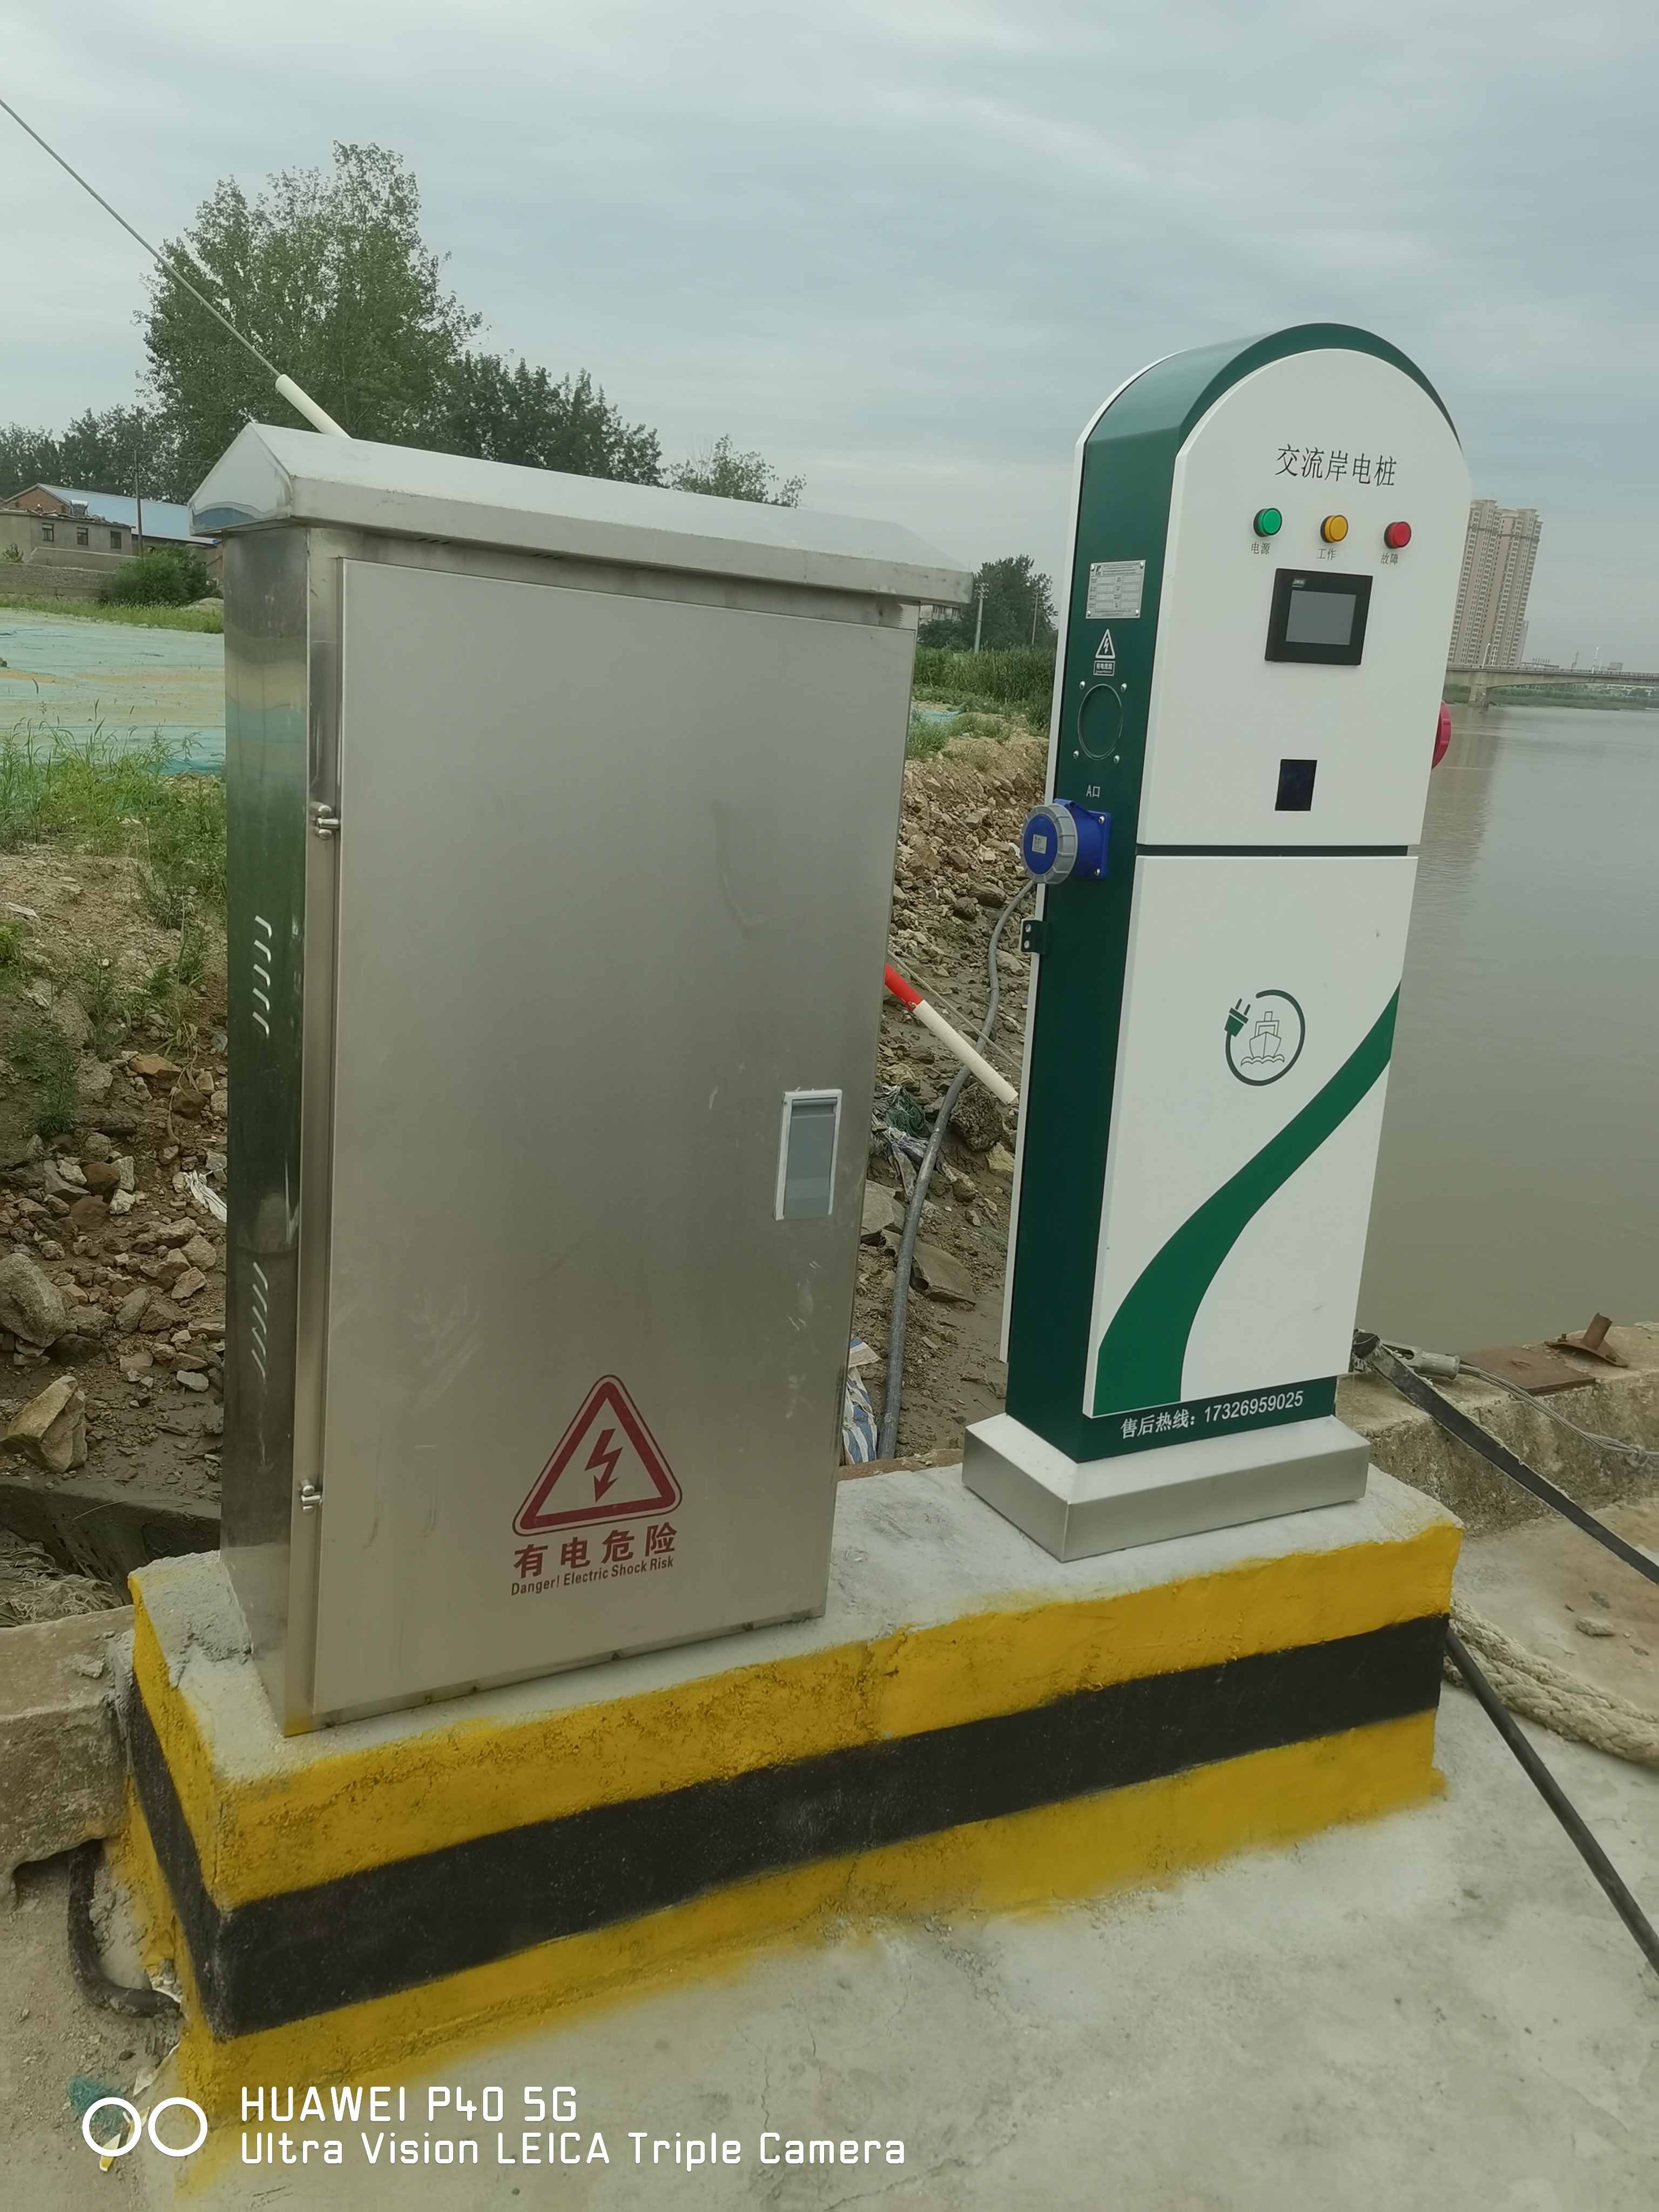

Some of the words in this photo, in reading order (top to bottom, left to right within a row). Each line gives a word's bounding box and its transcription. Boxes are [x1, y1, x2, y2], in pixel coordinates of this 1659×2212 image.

[1274, 443, 1397, 487] 交流岸电桩
[1251, 541, 1271, 555] 电源
[1317, 548, 1337, 561] 工作
[1380, 552, 1399, 565] 故障
[514, 1522, 677, 1579] 有电危险
[511, 1575, 559, 1596] Danger!
[563, 1567, 608, 1586] Electric
[611, 1560, 647, 1578] Shock
[650, 1555, 673, 1571] Risk
